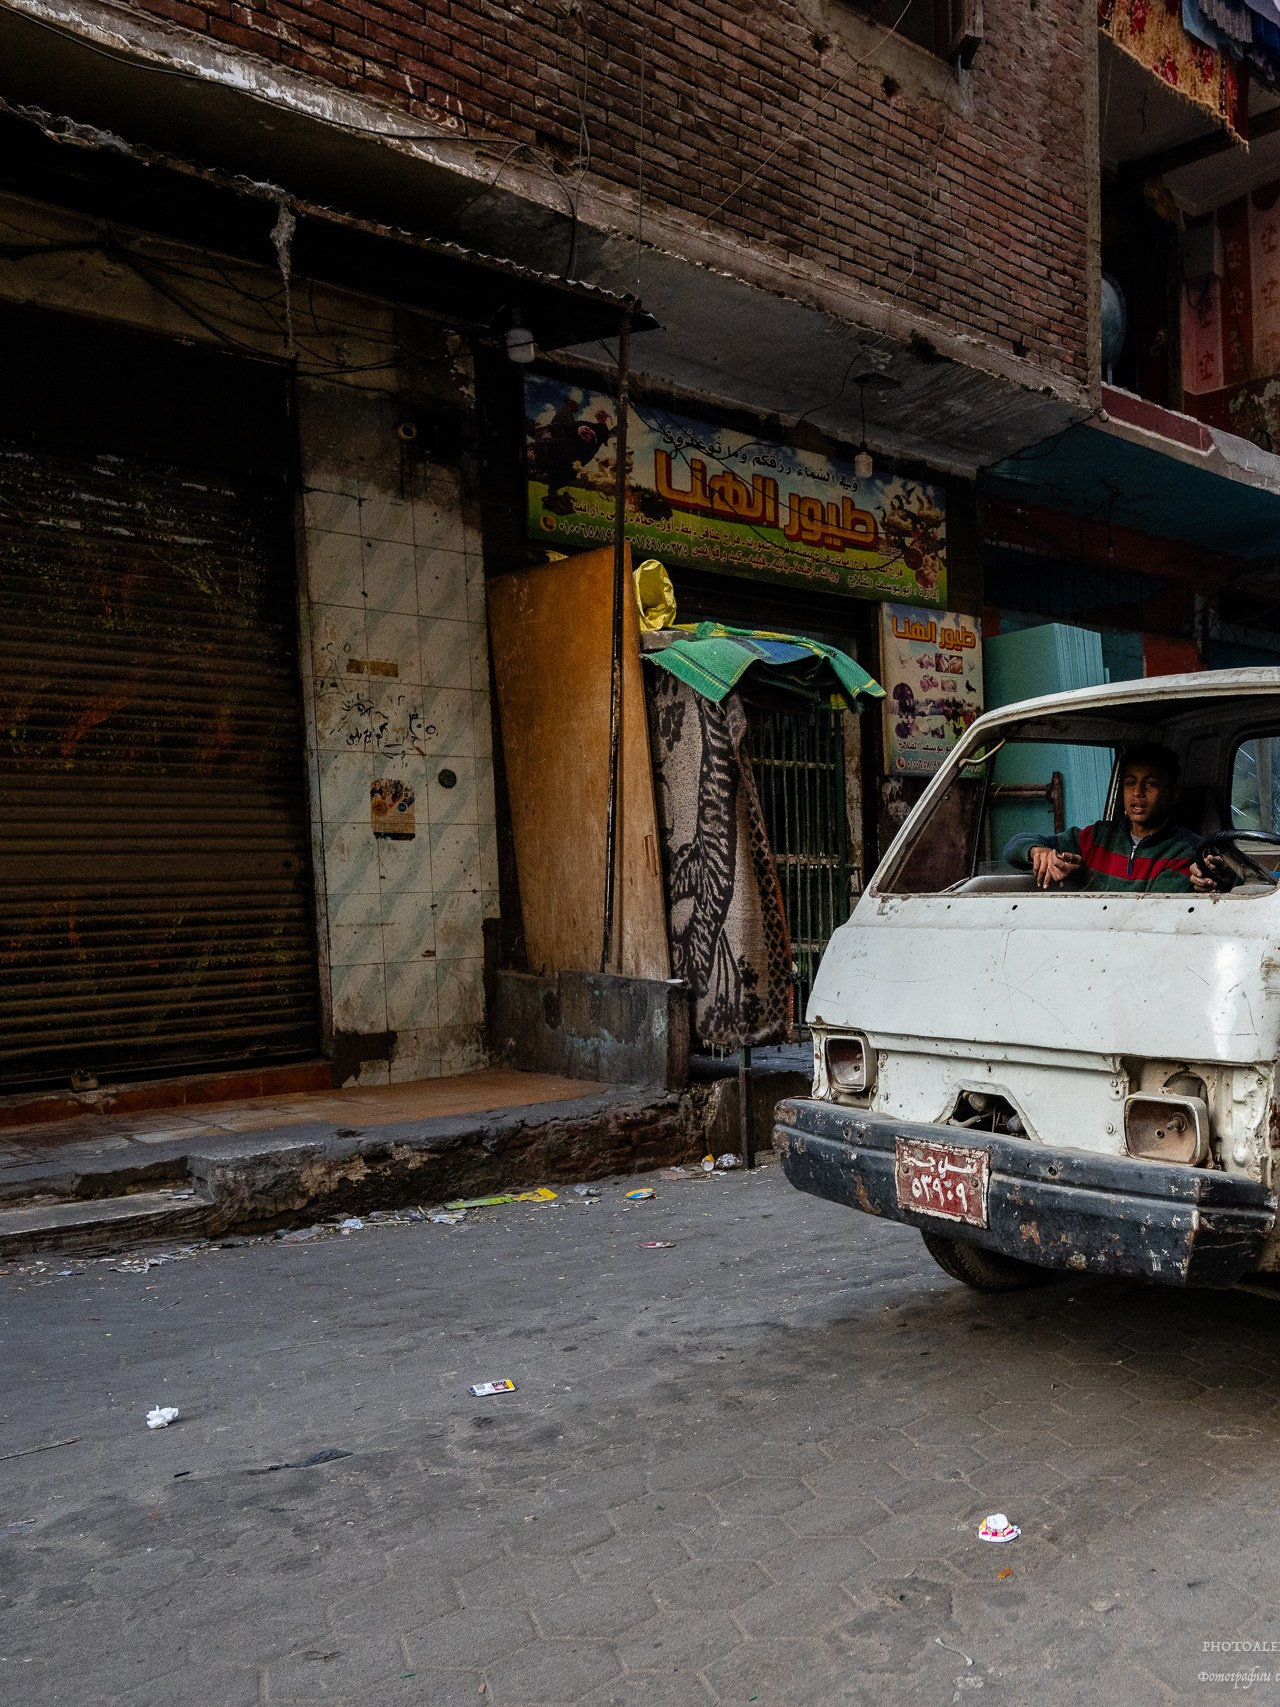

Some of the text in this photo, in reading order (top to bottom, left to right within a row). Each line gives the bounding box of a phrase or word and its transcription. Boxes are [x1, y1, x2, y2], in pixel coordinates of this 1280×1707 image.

[654, 448, 879, 552] طيور الهنا
[634, 512, 654, 527] حمام
[680, 523, 691, 537] بط
[722, 530, 740, 548] فراخ
[848, 573, 873, 589] الفلاح
[875, 578, 900, 595] يوسف
[892, 615, 976, 651] طيور الهنا
[898, 739, 921, 752] الفلاح
